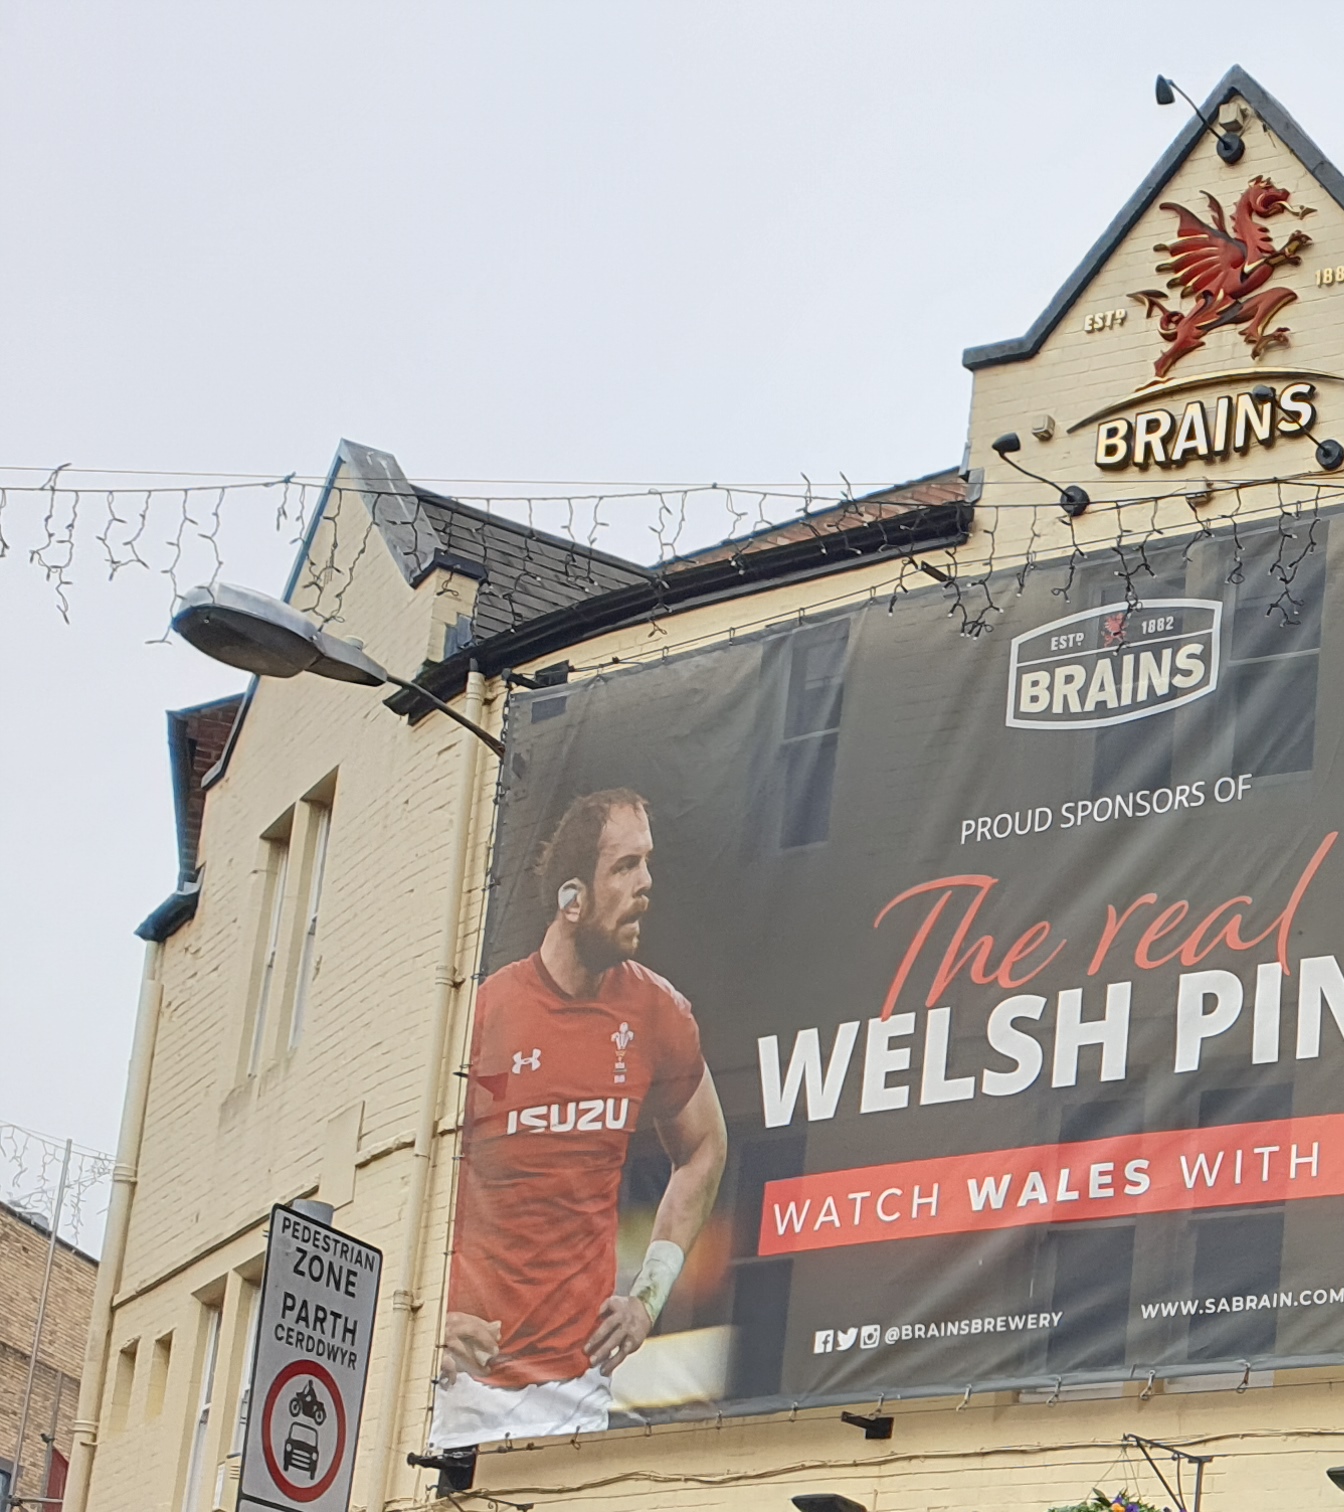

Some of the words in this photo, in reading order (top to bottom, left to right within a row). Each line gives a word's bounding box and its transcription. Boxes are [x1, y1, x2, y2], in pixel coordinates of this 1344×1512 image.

[1094, 380, 1320, 472] BRAINS
[1141, 616, 1175, 635] 1882
[1019, 642, 1206, 714] BRAINS
[960, 806, 1053, 845] PROUD
[1060, 780, 1206, 829] SPONSORS
[1214, 773, 1253, 804] OF
[873, 873, 1066, 1022] The
[1088, 829, 1340, 977] real
[756, 981, 1133, 1129] WELSH
[507, 1098, 629, 1135] ISUZU
[772, 1183, 941, 1237] WATCH
[966, 1157, 1152, 1212] WALES
[1180, 1140, 1320, 1190] WITH
[281, 1217, 375, 1273] PEDESTRIAN
[293, 1247, 358, 1299] ZONE
[274, 1323, 357, 1371] CERDDWYR
[280, 1291, 358, 1347] PARTH
[884, 1311, 1063, 1345] @BRAINSBREWERY
